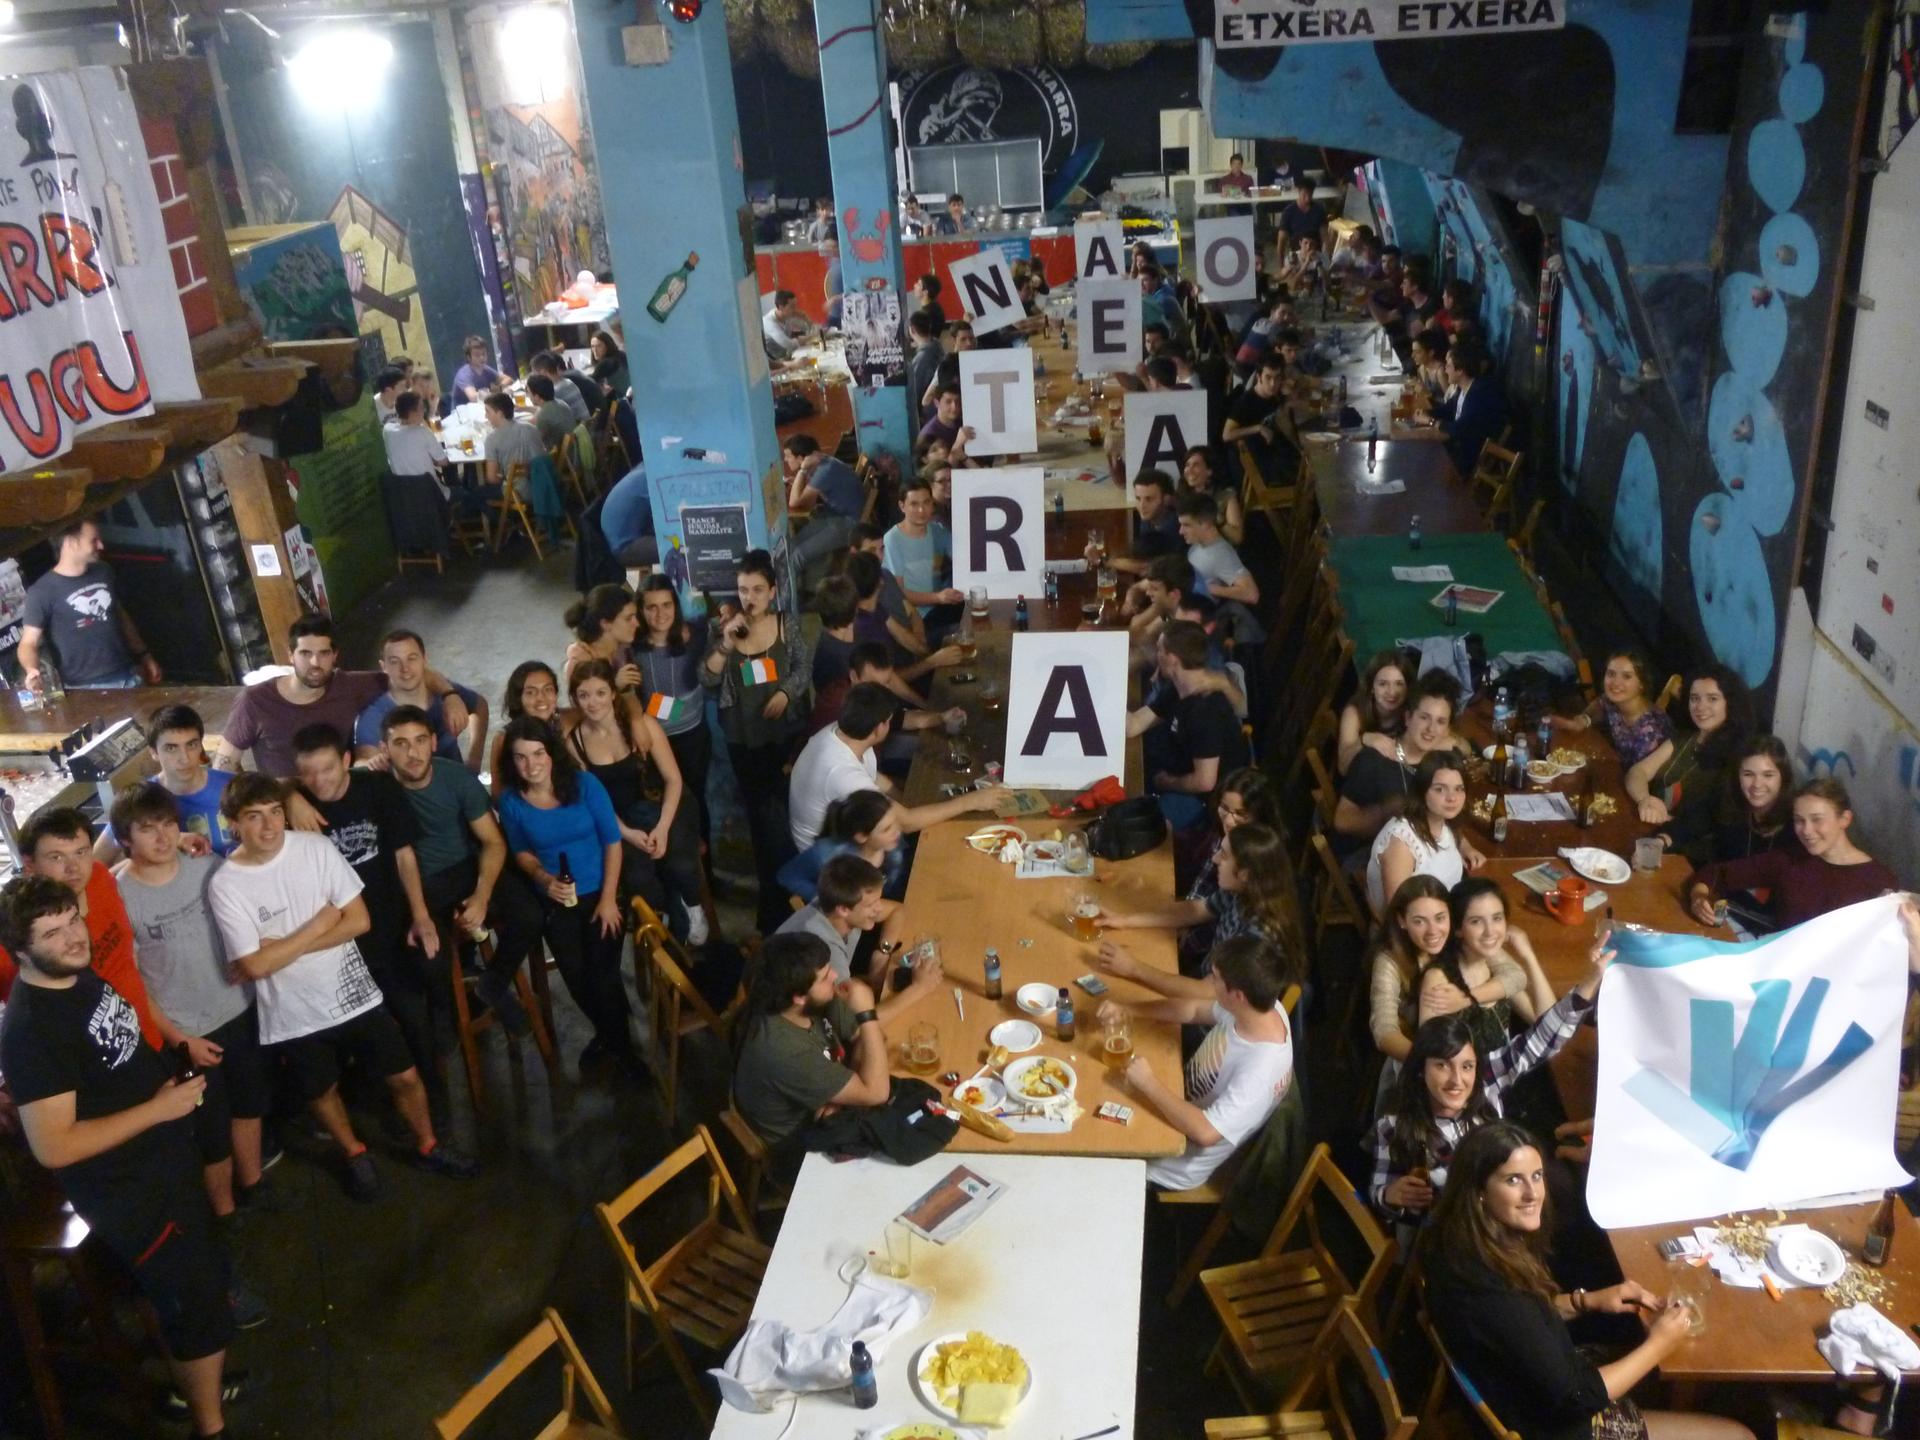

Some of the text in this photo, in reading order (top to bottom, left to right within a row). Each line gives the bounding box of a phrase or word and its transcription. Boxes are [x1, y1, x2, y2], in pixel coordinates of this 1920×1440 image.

[1223, 0, 1556, 41] ETXERA ETXERA
[0, 178, 18, 207] TE
[1084, 236, 1118, 277] A
[1204, 237, 1249, 286] O
[962, 264, 1012, 318] N
[1093, 299, 1126, 353] E
[0, 329, 151, 472] UGU
[974, 371, 1019, 433] T
[1139, 414, 1191, 481] A
[969, 496, 1025, 572] R
[1020, 665, 1108, 756] A
